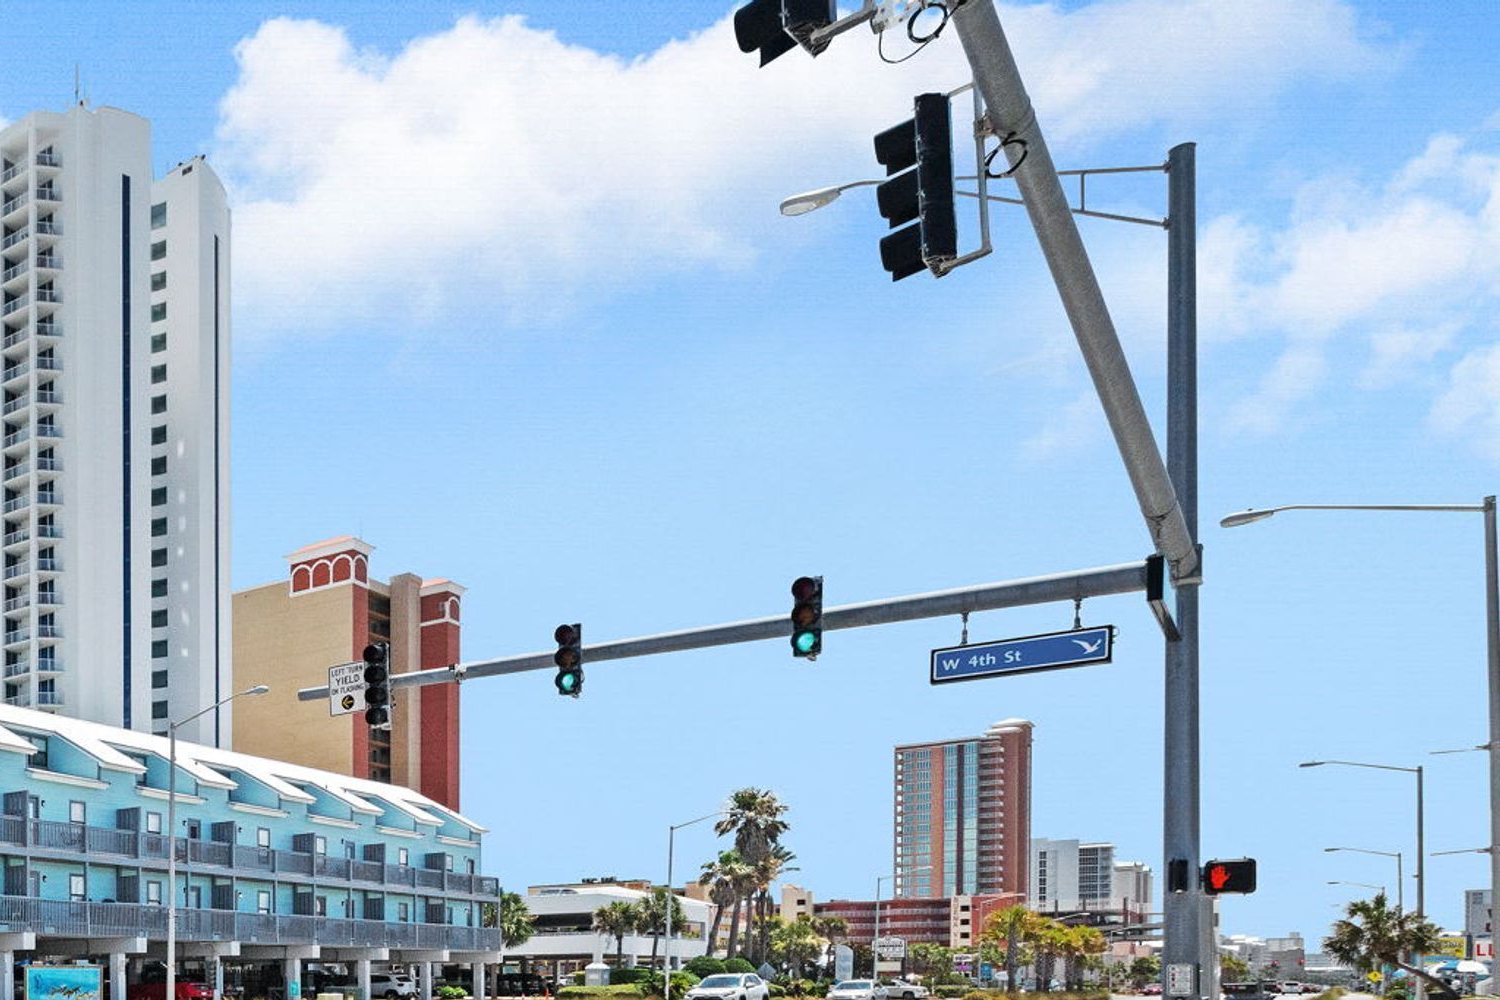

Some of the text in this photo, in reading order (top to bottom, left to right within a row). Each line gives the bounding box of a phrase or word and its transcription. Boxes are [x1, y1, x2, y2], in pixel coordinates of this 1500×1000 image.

[941, 650, 1021, 671] W 4th St
[331, 664, 363, 678] LEFT TURN
[335, 673, 360, 686] YIELD
